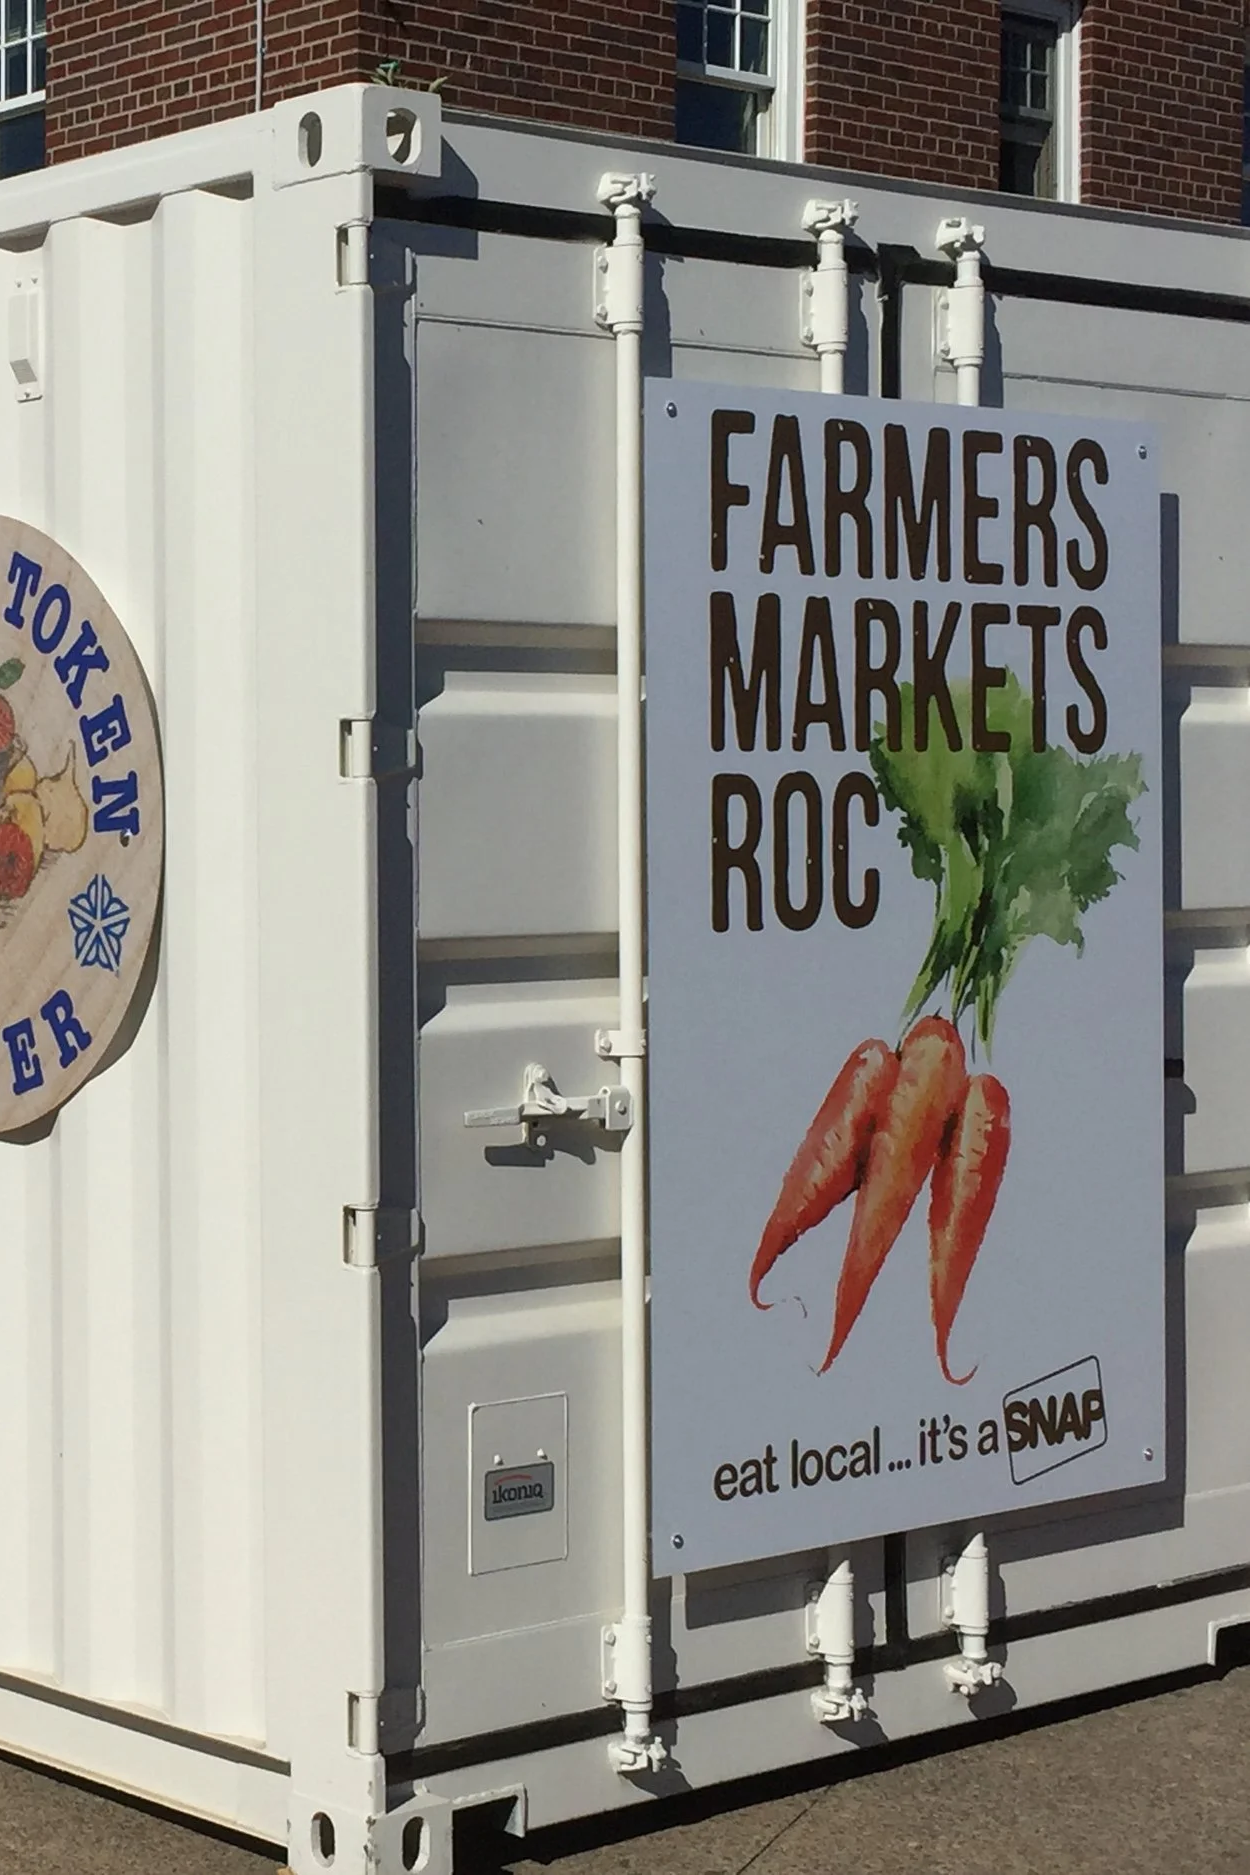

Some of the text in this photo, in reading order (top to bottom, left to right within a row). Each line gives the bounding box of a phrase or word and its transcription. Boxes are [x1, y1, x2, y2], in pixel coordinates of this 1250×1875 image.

[710, 408, 1110, 592] FARMERS
[4, 551, 141, 837] TOKEN
[709, 591, 1109, 754] MARKETS
[711, 770, 880, 933] ROC
[713, 1444, 780, 1501] eat
[918, 1413, 968, 1466] it's
[977, 1418, 1000, 1456] a
[1003, 1389, 1104, 1453] SNAP
